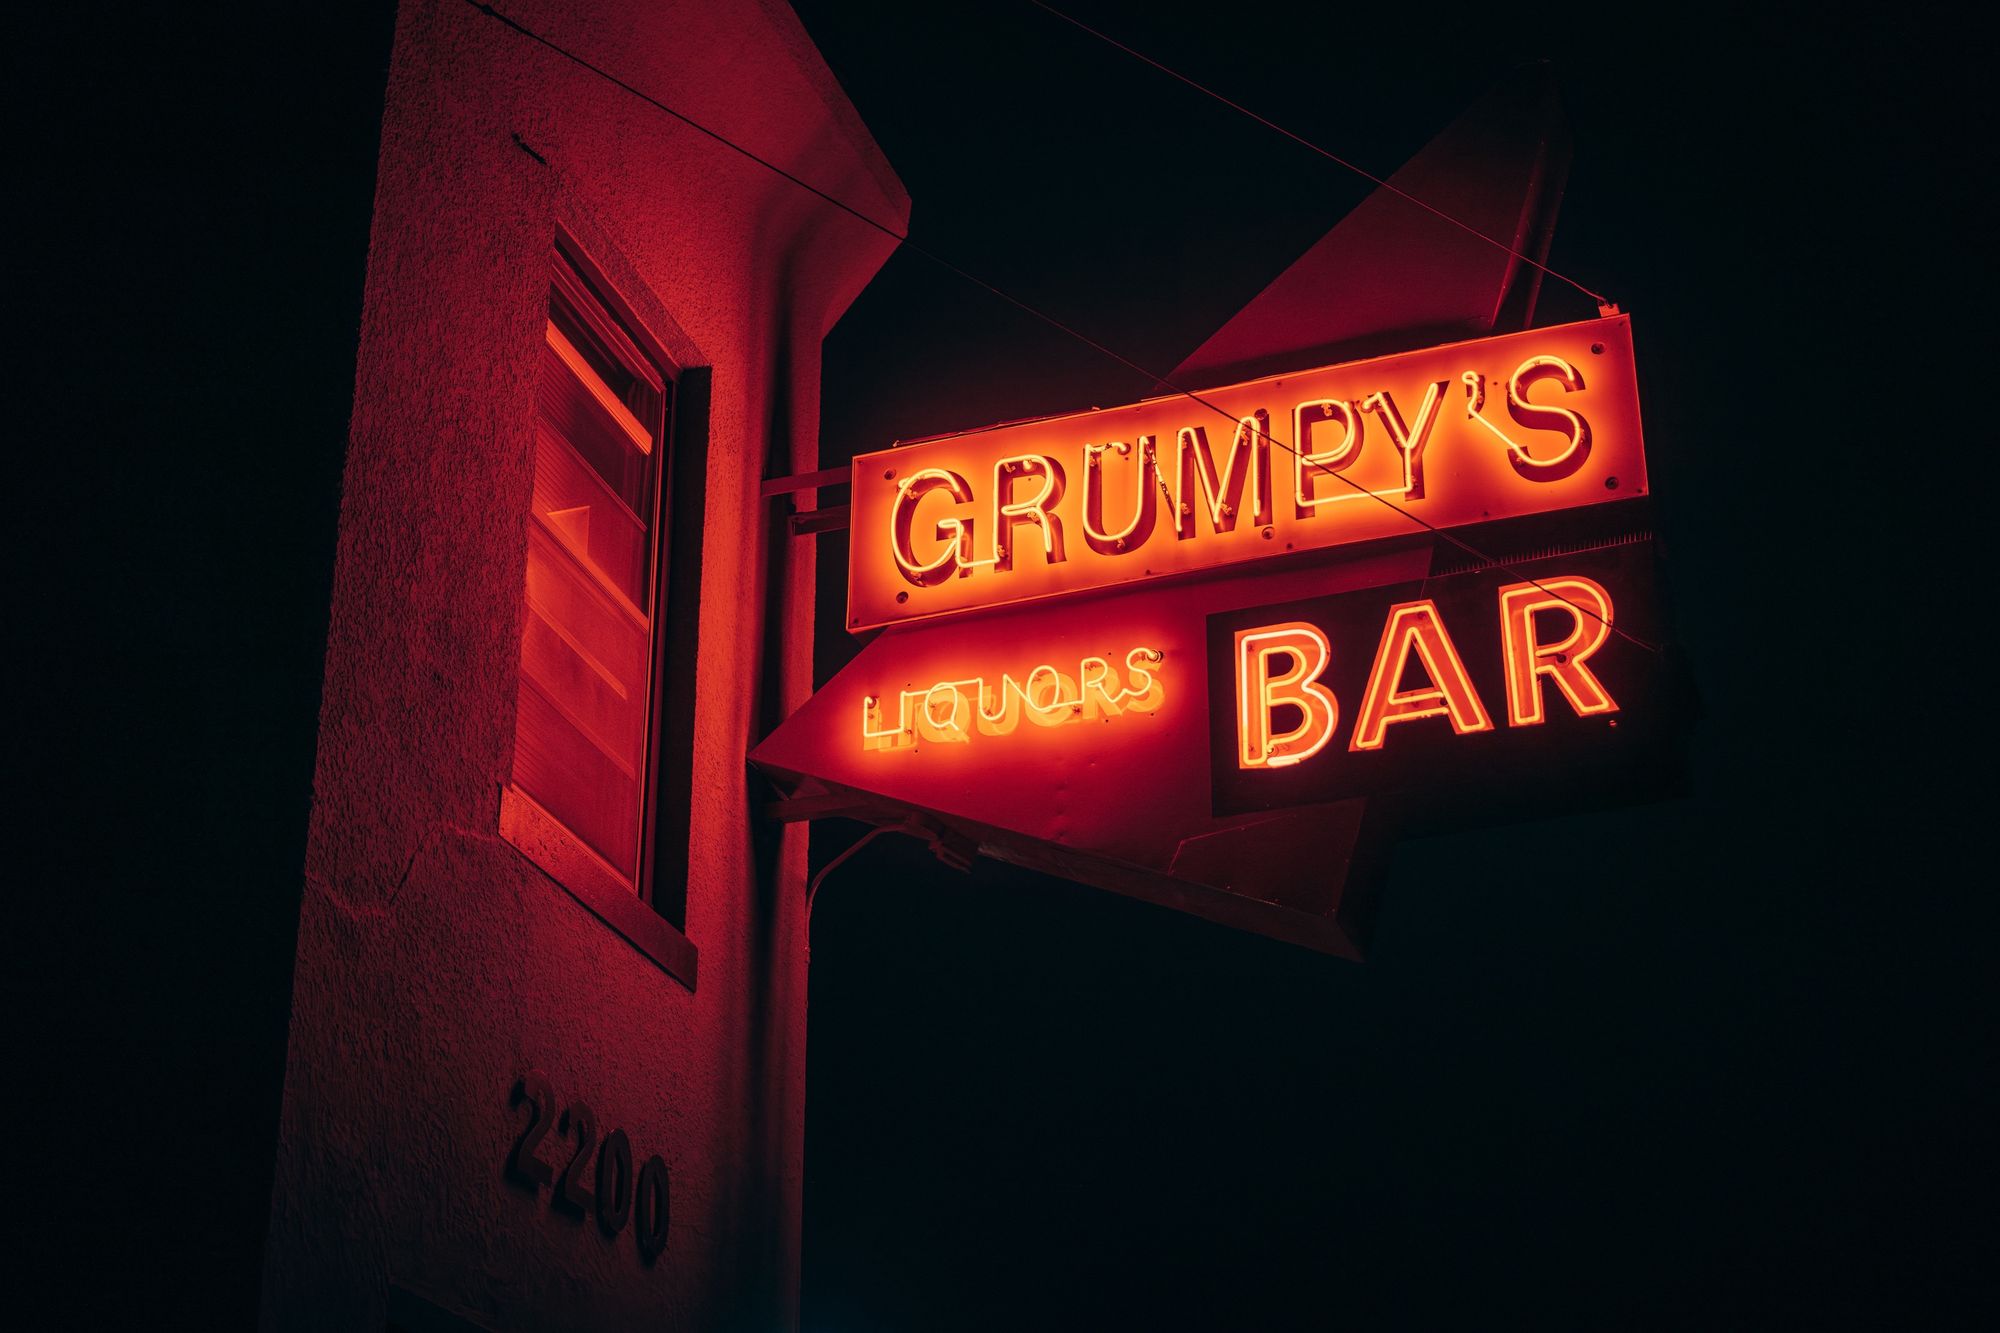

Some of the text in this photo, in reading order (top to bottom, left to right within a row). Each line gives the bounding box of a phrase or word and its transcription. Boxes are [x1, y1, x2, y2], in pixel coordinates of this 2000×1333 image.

[890, 354, 1593, 587] GRUMPY'S
[863, 647, 1166, 752] LIQUORS
[1234, 575, 1621, 769] BAR
[504, 1068, 671, 1268] 2200
